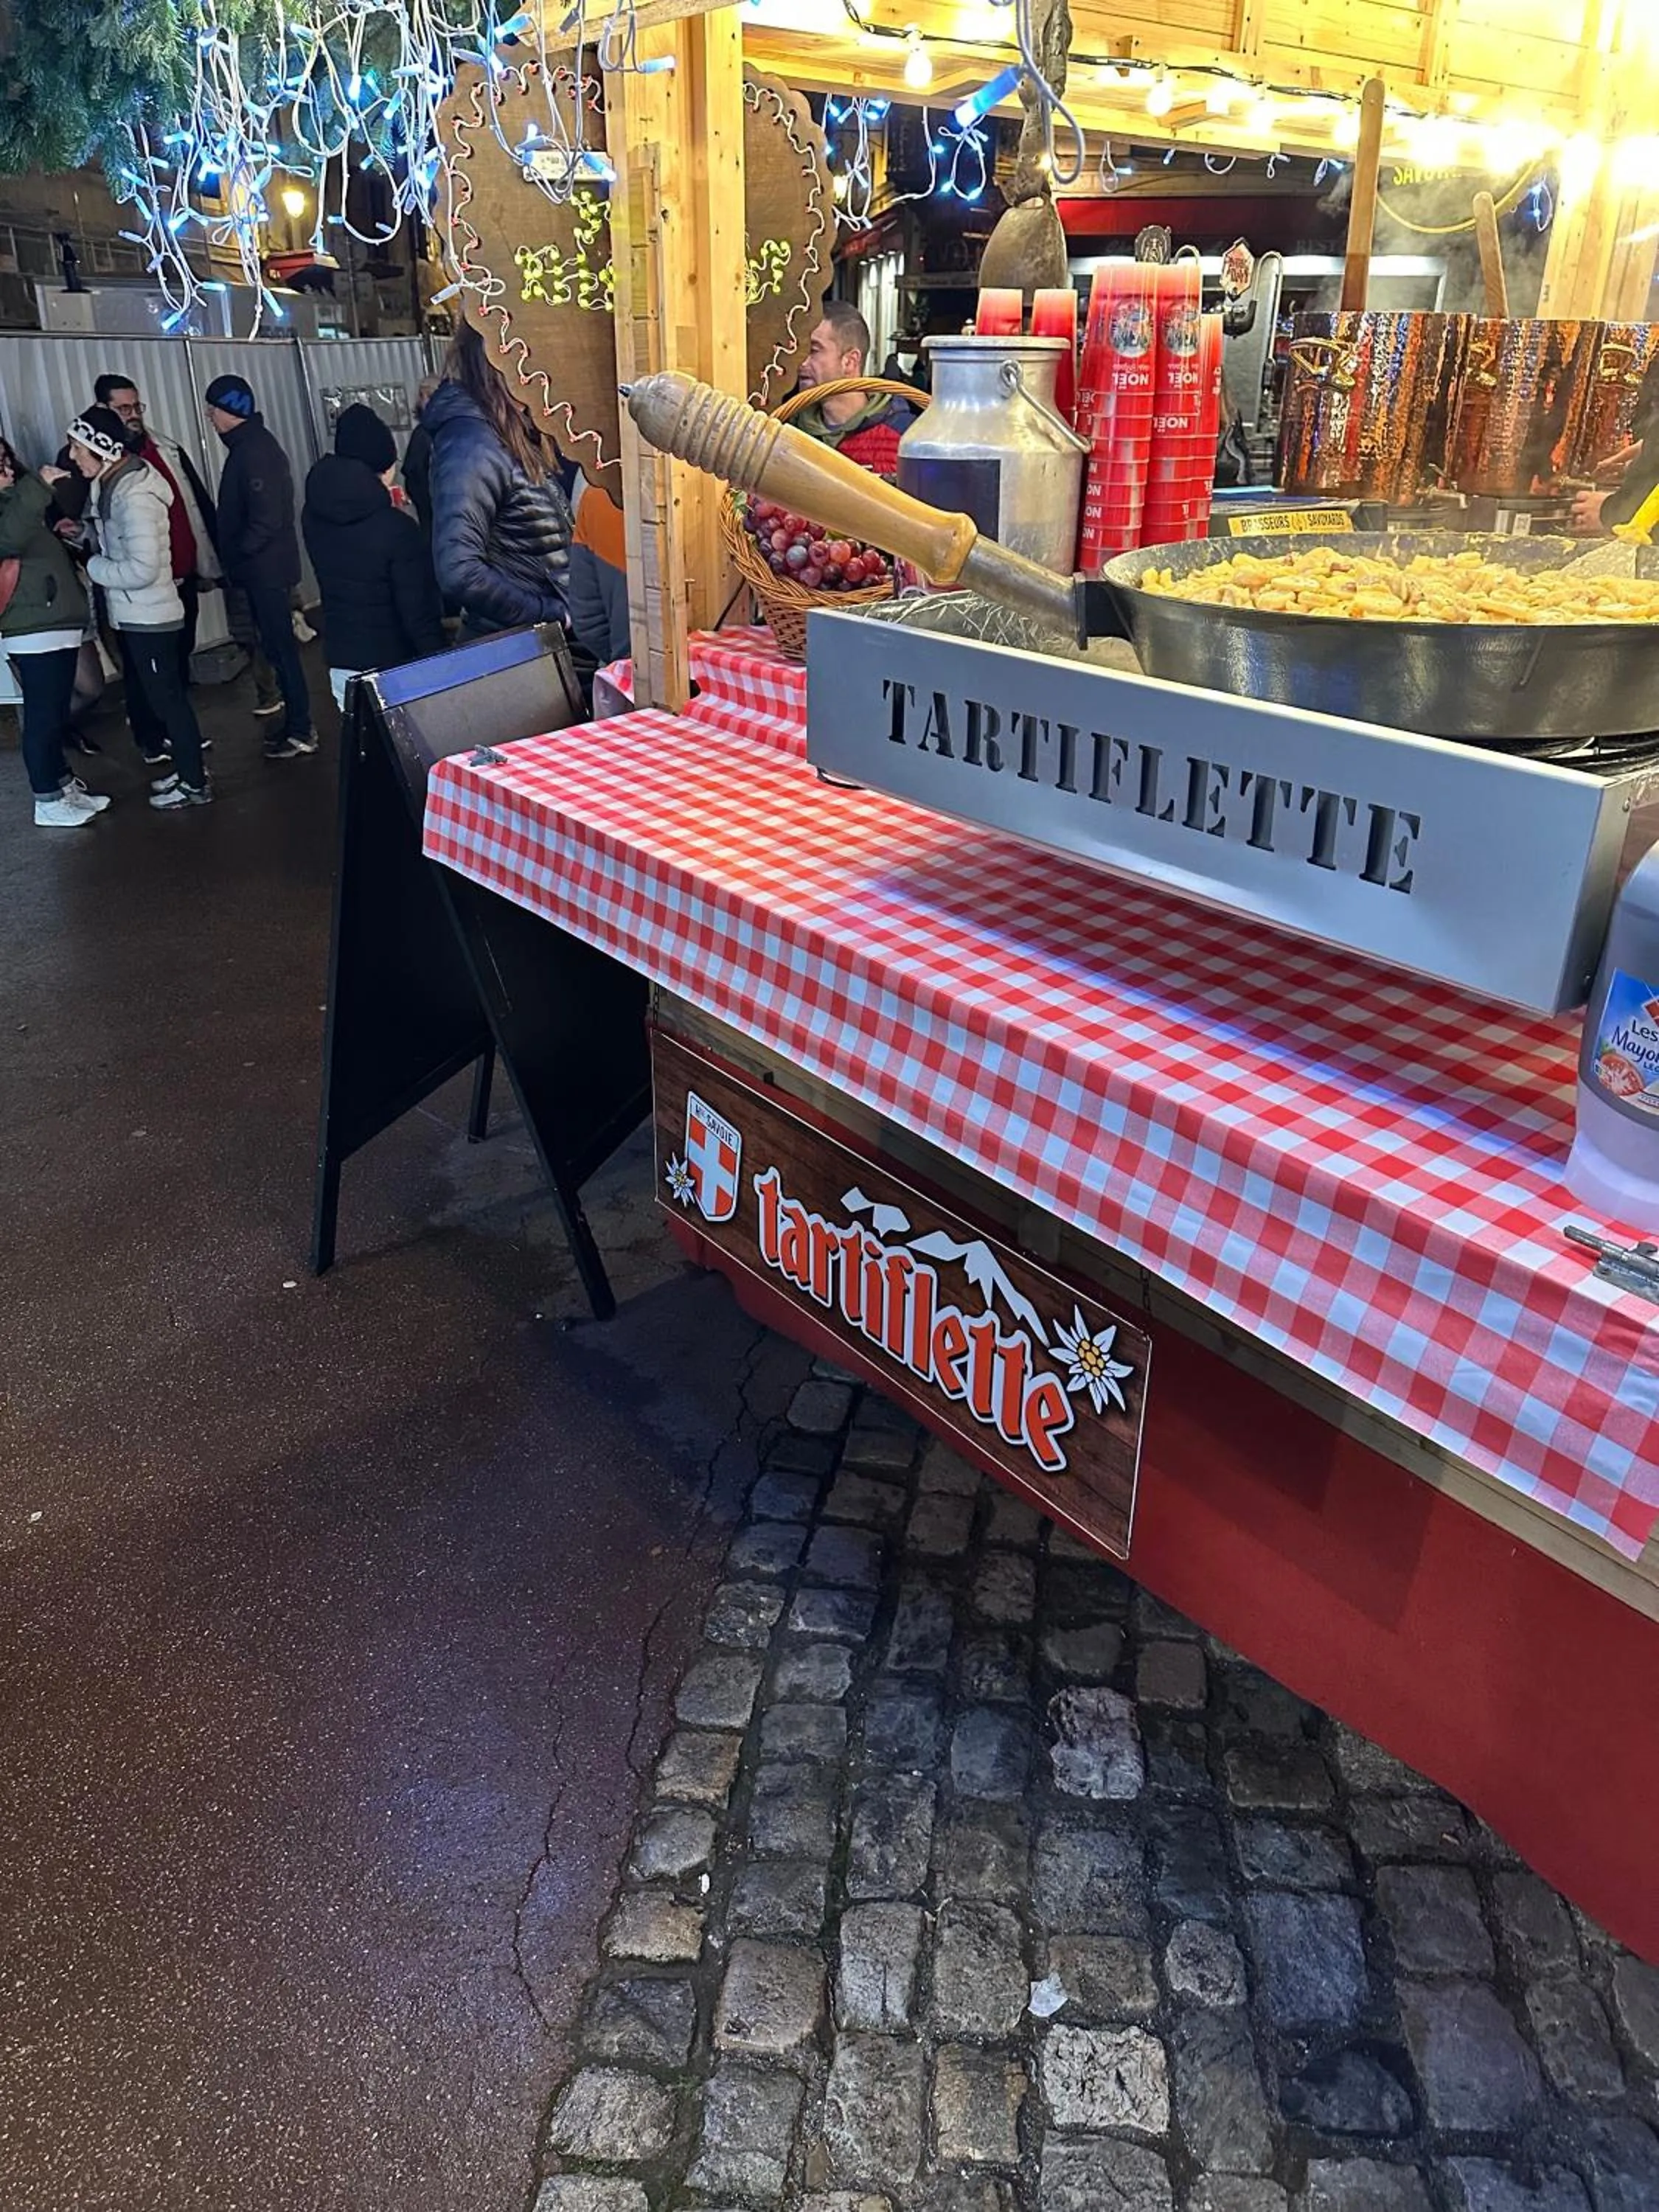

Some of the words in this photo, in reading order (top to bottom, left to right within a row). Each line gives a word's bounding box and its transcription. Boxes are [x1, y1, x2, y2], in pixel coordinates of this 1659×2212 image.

[1113, 372, 1150, 389] NOËL
[883, 679, 1420, 894] TARTIFLETTE
[755, 1168, 1074, 1471] tartiflette
